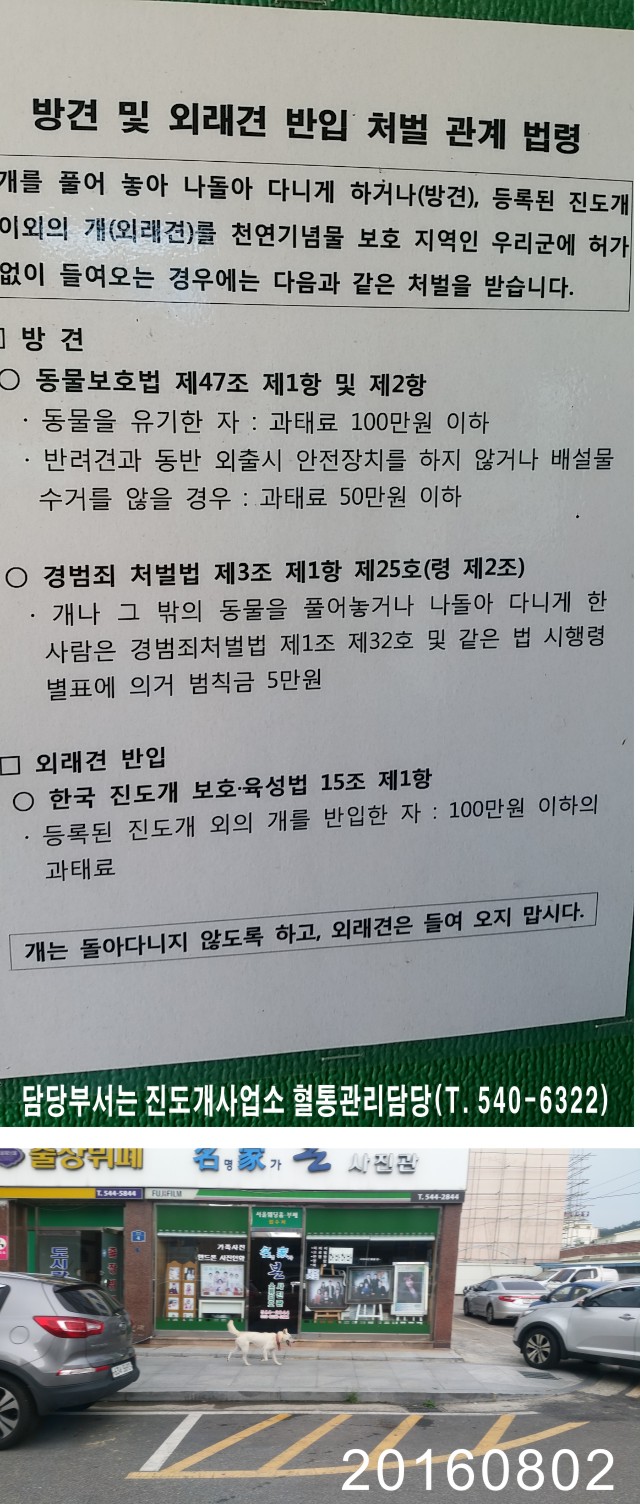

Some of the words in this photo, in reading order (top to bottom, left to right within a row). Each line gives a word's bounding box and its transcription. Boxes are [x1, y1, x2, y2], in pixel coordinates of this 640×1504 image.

[33, 98, 97, 131] 방견
[119, 101, 149, 134] 및
[169, 103, 266, 137] 외래견
[287, 108, 347, 141] 반입
[367, 112, 427, 145] 처벌
[446, 117, 505, 150] 관계
[524, 122, 580, 154] 법령
[0, 170, 42, 193] 개를
[59, 171, 104, 195] 풀어
[121, 173, 168, 197] 놓아
[185, 175, 253, 200] 나돌아
[269, 178, 334, 203] 다니게
[350, 179, 479, 208] 하거나(방견),
[493, 188, 553, 212] 등록된
[569, 192, 628, 216] 진도개
[0, 216, 67, 241] 이외의
[84, 218, 216, 245] 개(외래견)를
[232, 222, 344, 249] 천연기념물
[358, 228, 400, 248] 보호
[415, 229, 477, 252] 지역인
[492, 232, 575, 256] 우리군에
[589, 235, 629, 258] 허가
[0, 262, 44, 286] 없이
[60, 263, 154, 289] 들여오는
[169, 267, 260, 292] 경우에는
[274, 271, 340, 295] 다음과
[353, 272, 395, 295] 같은
[408, 274, 471, 297] 처벌을
[485, 275, 573, 299] 받습니다.
[22, 327, 45, 351] 방
[61, 328, 83, 351] 견
[36, 369, 159, 394] 동물보호법
[176, 371, 249, 395] 제47조
[263, 372, 322, 396] 제1항
[336, 373, 355, 396] 및
[369, 374, 427, 397] 제2항
[42, 409, 116, 433] 동물을
[131, 410, 203, 434] 유기한
[218, 410, 239, 434] 자
[269, 411, 338, 434] 과태료
[352, 412, 431, 434] 100만원
[447, 411, 489, 434] 이하
[45, 448, 142, 472] 반려견과
[155, 449, 201, 472] 동반
[215, 449, 281, 472] 외출시
[297, 449, 406, 472] 안전장치를
[419, 449, 460, 471] 하지
[475, 448, 538, 471] 않거나
[552, 448, 614, 470] 배설물
[39, 487, 112, 511] 수거를
[127, 487, 172, 510] 않을
[186, 487, 231, 510] 경우
[260, 486, 327, 509] 과태료
[340, 486, 405, 508] 50만원
[421, 485, 462, 508] 이하
[44, 564, 114, 588] 경범죄
[131, 562, 198, 586] 처벌법
[214, 562, 272, 585] 제3조
[286, 560, 342, 583] 제1항
[355, 558, 449, 581] 제25호(령
[463, 557, 524, 579] 제2조)
[53, 602, 100, 626] 개나
[118, 604, 140, 620] 그
[158, 600, 201, 623] 밖의
[220, 598, 287, 621] 동물을
[304, 595, 414, 619] 풀어놓거나
[431, 593, 493, 616] 나돌아
[510, 591, 570, 614] 다니게
[588, 590, 607, 612] 한
[45, 640, 116, 664] 사람은
[131, 635, 265, 661] 경범죄처벌법
[281, 634, 335, 655] 제1조
[348, 631, 413, 653] 제32호
[429, 629, 445, 650] 및
[459, 628, 500, 649] 같은
[514, 627, 530, 648] 법
[544, 625, 604, 647] 시행령
[47, 676, 114, 701] 별표에
[130, 674, 172, 697] 의거
[190, 672, 254, 694] 범칙금
[268, 668, 321, 690] 5만원
[36, 750, 106, 774] 외래견
[122, 747, 165, 769] 반입
[49, 787, 95, 810] 한국
[110, 781, 177, 806] 진도개
[192, 774, 306, 799] 보호·육성법
[322, 773, 365, 790] 15조
[378, 768, 432, 790] 제1항
[43, 821, 111, 846] 등록된
[129, 816, 194, 841] 진도개
[210, 812, 252, 835] 외의
[268, 809, 310, 831] 개를
[325, 804, 388, 828] 반입한
[401, 803, 421, 824] 자
[450, 797, 524, 819] 100만원
[539, 794, 597, 816] 이하의
[46, 858, 115, 881] 과태료
[25, 941, 68, 962] 개는
[80, 932, 187, 959] 돌아다니지
[201, 926, 263, 950] 않도록
[275, 924, 321, 944] 하고,
[332, 916, 413, 940] 외래견은
[424, 911, 462, 933] 들여
[474, 907, 511, 927] 오지
[524, 902, 584, 925] 맙시다.
[348, 1152, 419, 1174] 사진관
